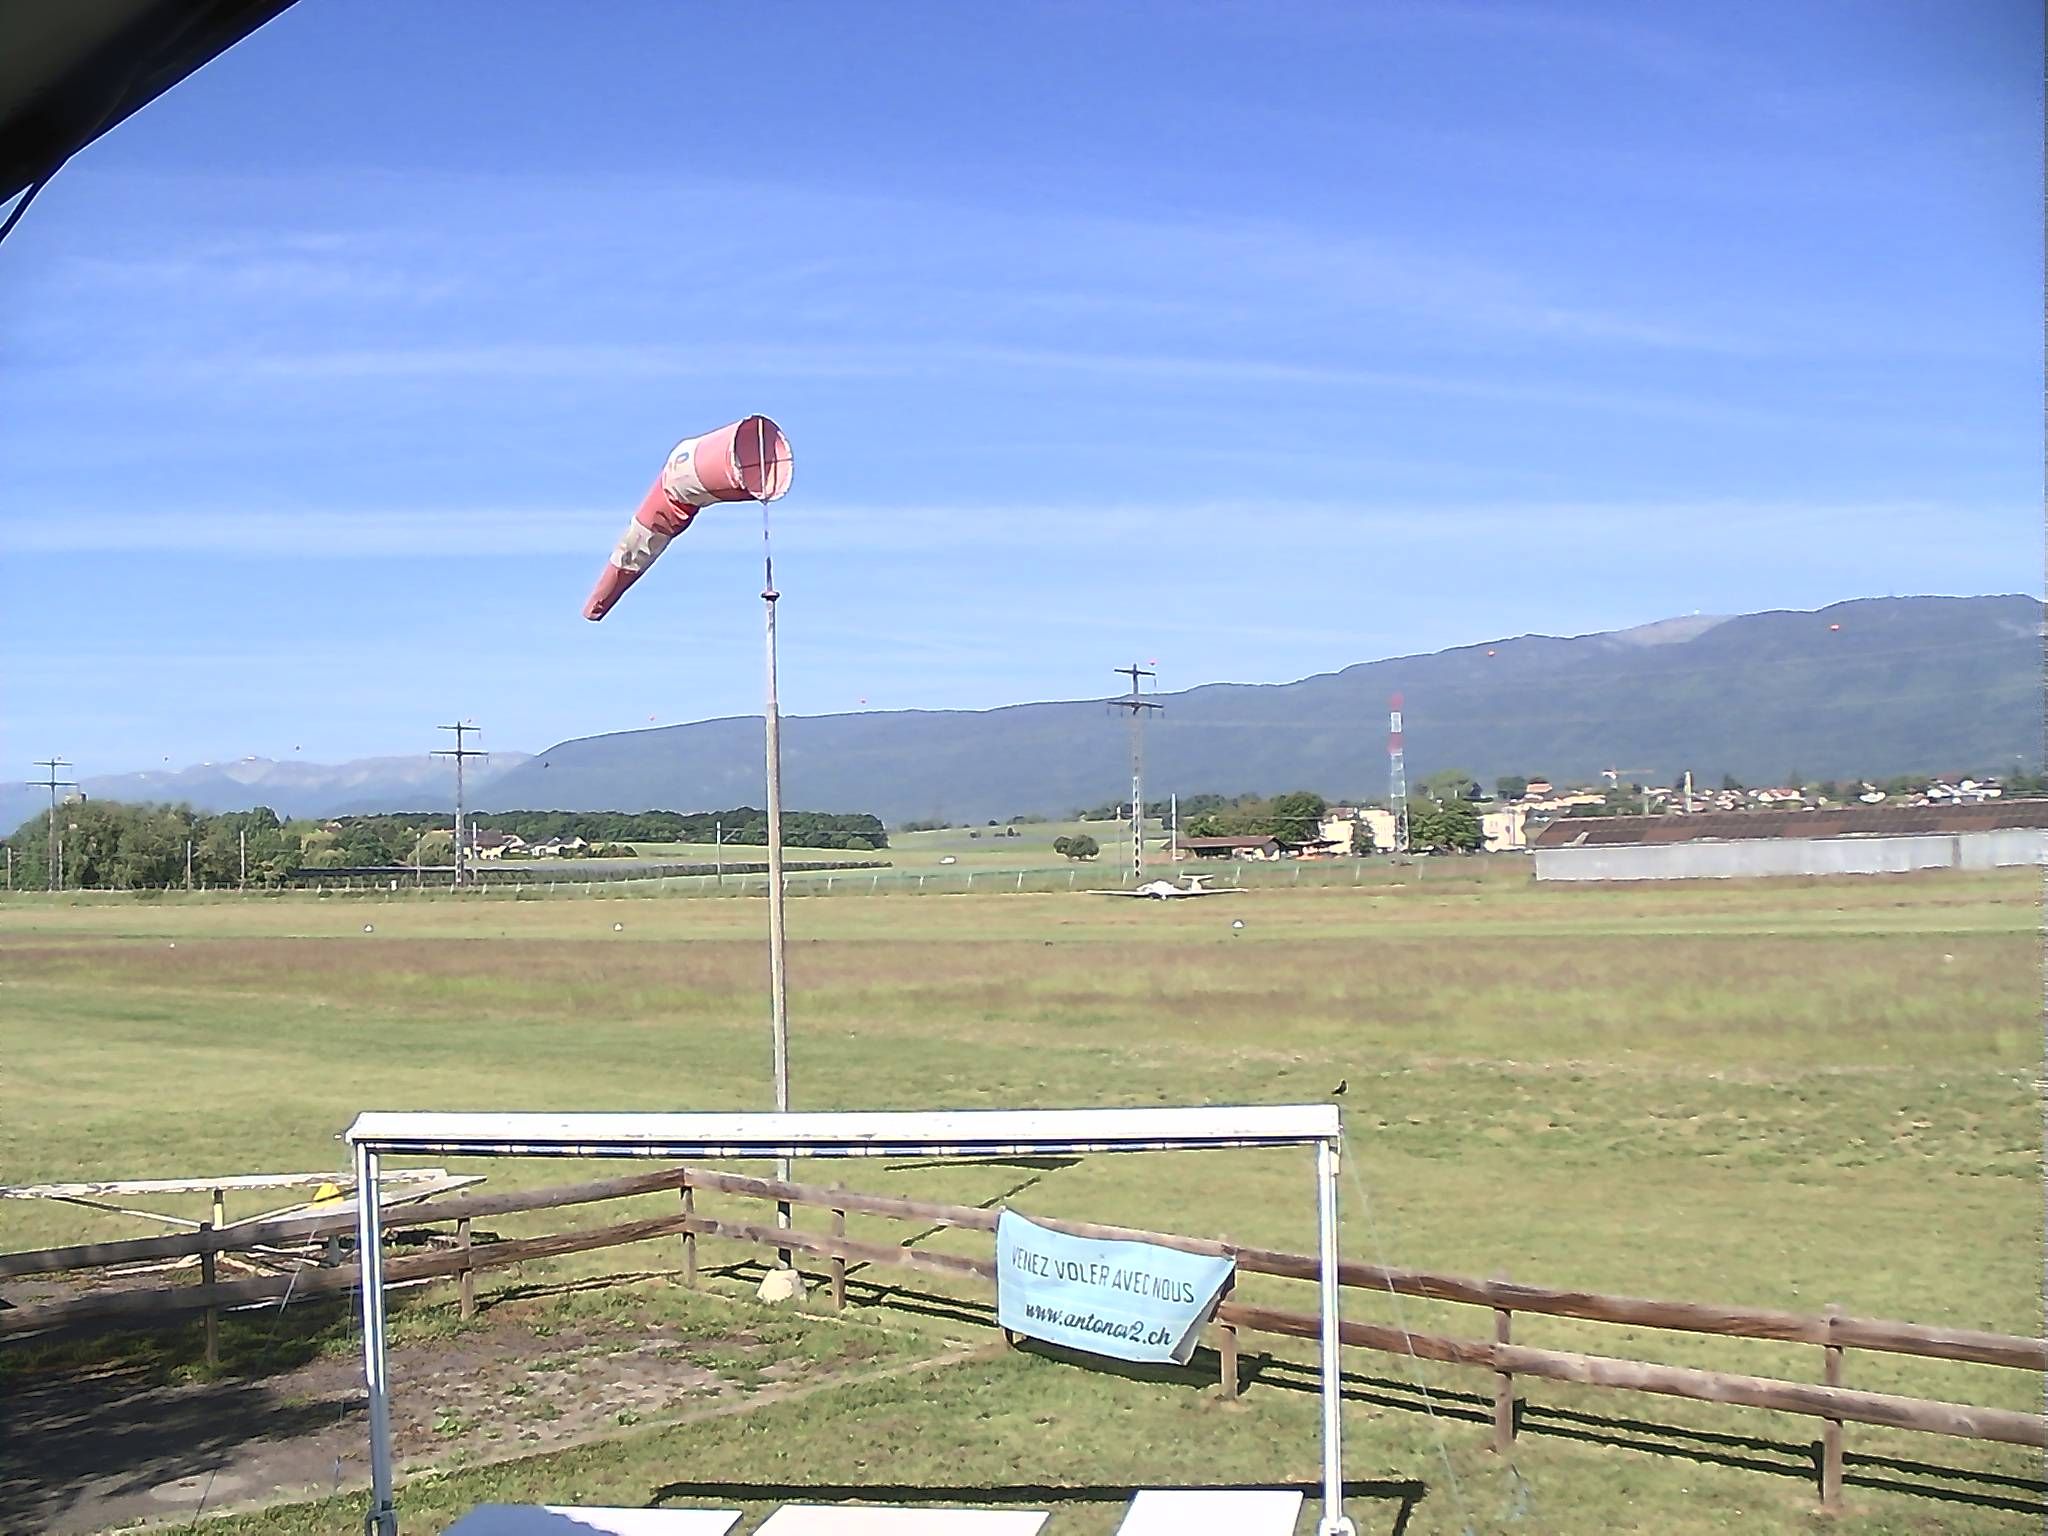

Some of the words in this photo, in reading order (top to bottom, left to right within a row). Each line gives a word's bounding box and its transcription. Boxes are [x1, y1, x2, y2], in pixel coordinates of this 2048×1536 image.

[1055, 1260, 1109, 1285] VOLER
[1112, 1268, 1150, 1295] AVEC
[1152, 1277, 1194, 1304] NOUS
